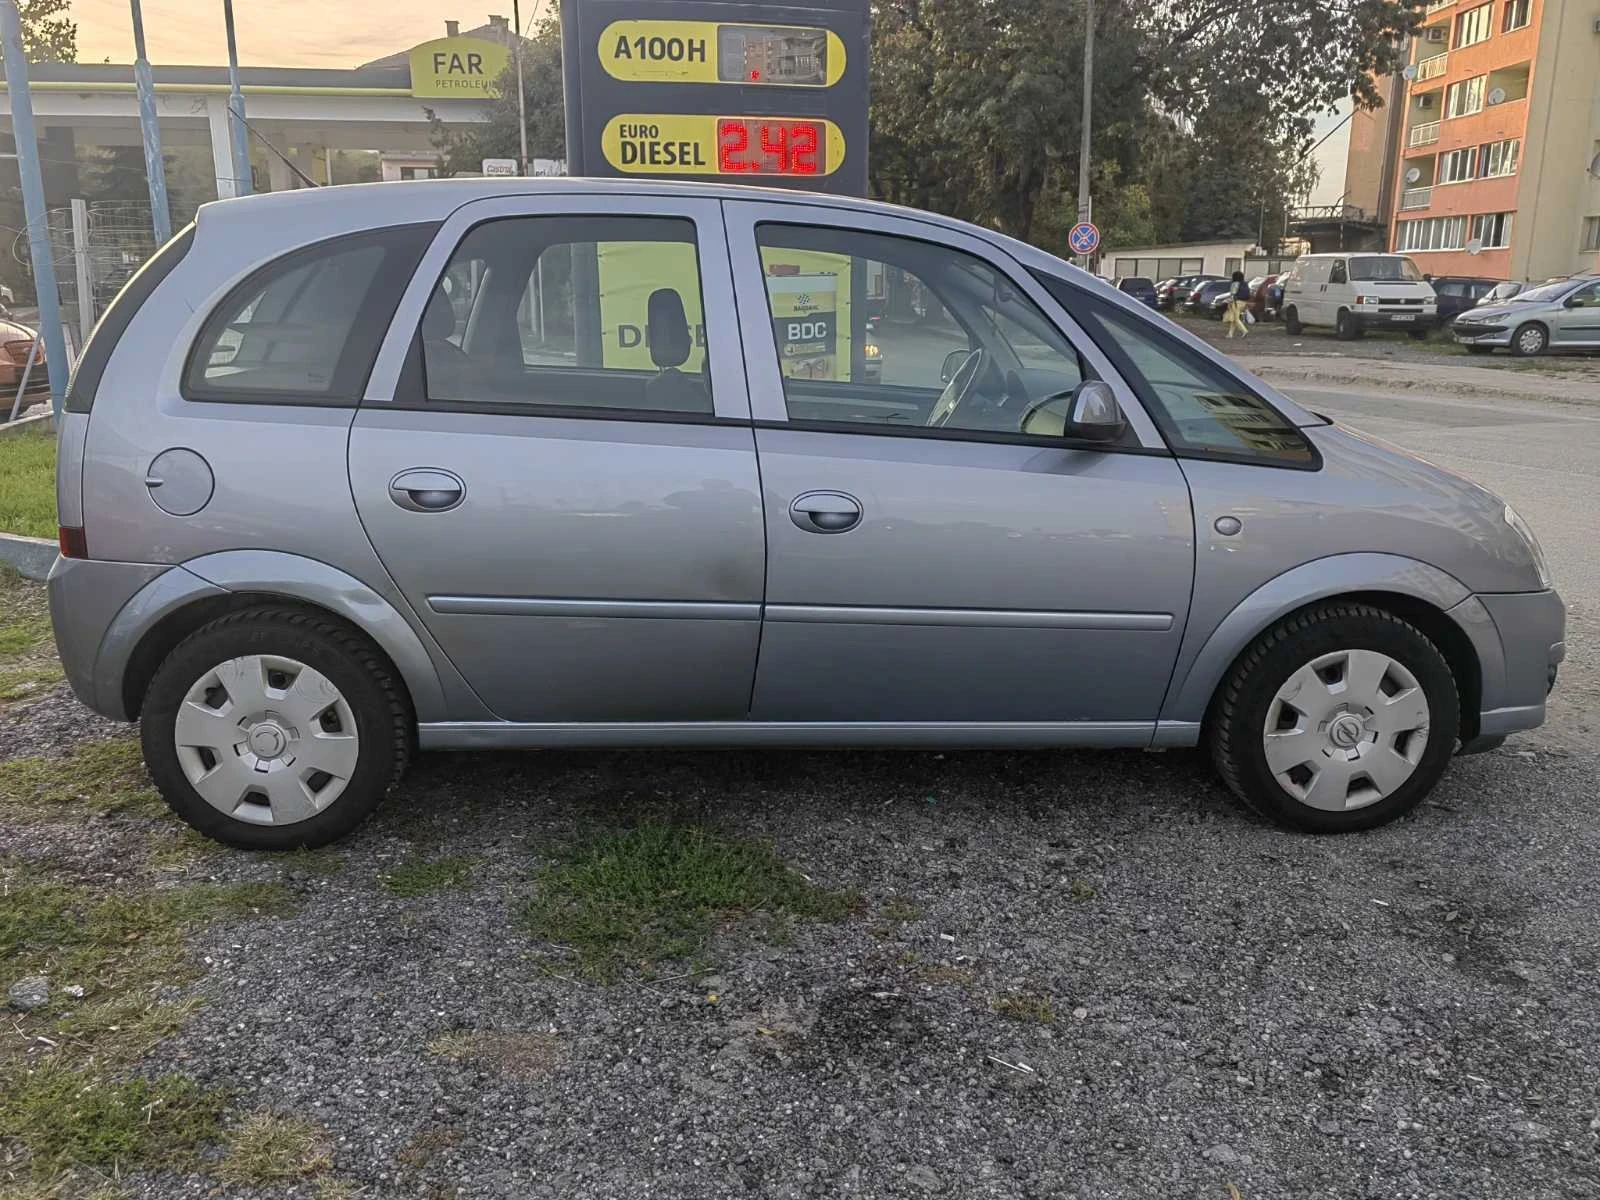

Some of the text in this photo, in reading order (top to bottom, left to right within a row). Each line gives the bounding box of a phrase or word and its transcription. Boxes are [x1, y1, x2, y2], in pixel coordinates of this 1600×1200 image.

[614, 35, 706, 62] A100H
[433, 53, 483, 74] FAR
[619, 124, 659, 138] EURO
[620, 141, 706, 166] DIESEL
[720, 121, 817, 174] 2.42
[788, 322, 827, 340] BDC
